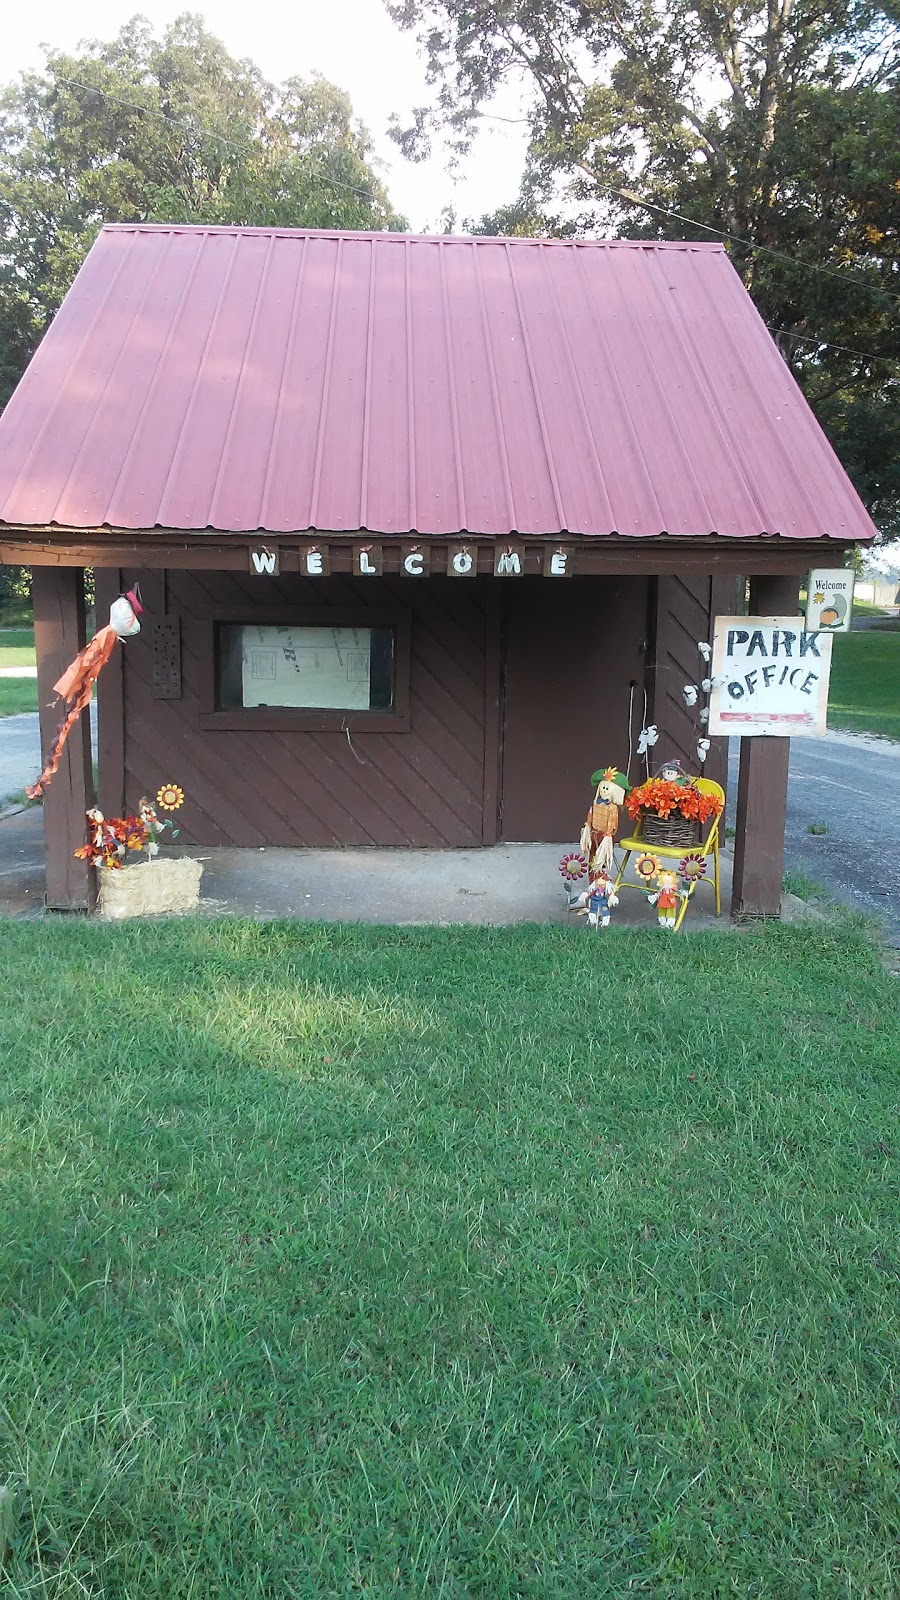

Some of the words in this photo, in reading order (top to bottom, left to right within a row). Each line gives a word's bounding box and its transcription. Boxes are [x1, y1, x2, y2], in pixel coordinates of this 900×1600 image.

[252, 553, 568, 575] WELCOME
[815, 580, 847, 590] Welcome
[726, 630, 821, 657] PARK
[727, 664, 819, 700] OFFICE
